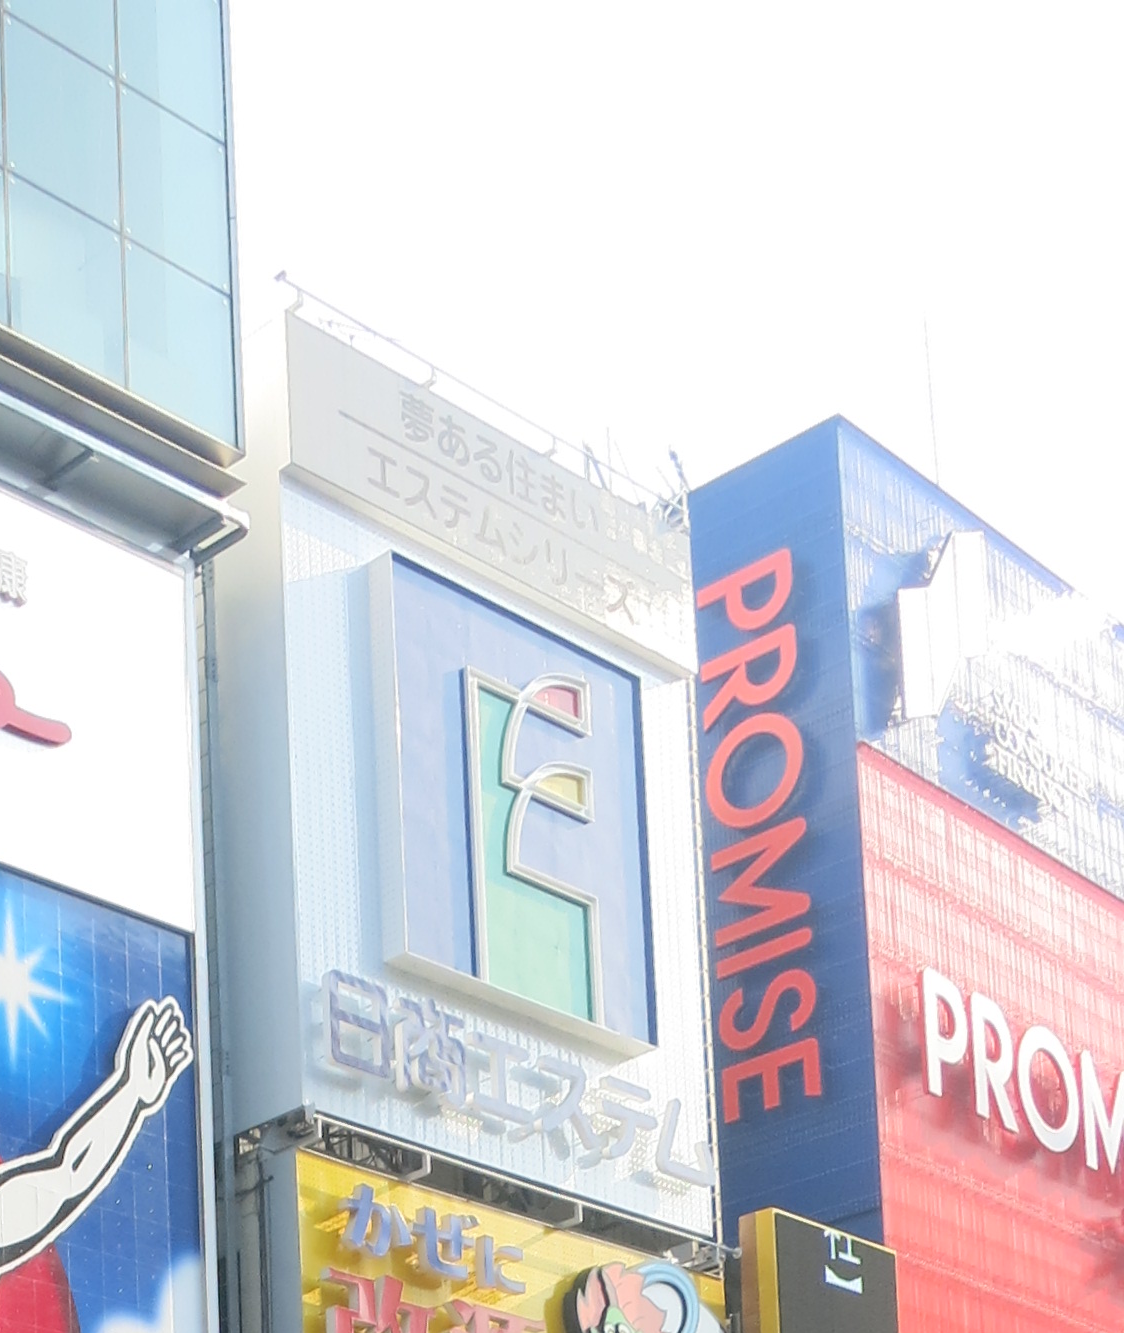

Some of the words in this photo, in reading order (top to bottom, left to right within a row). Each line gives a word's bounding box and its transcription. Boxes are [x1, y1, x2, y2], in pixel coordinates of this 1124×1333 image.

[696, 548, 824, 1125] PROMISE
[338, 1183, 526, 1293] かぜに
